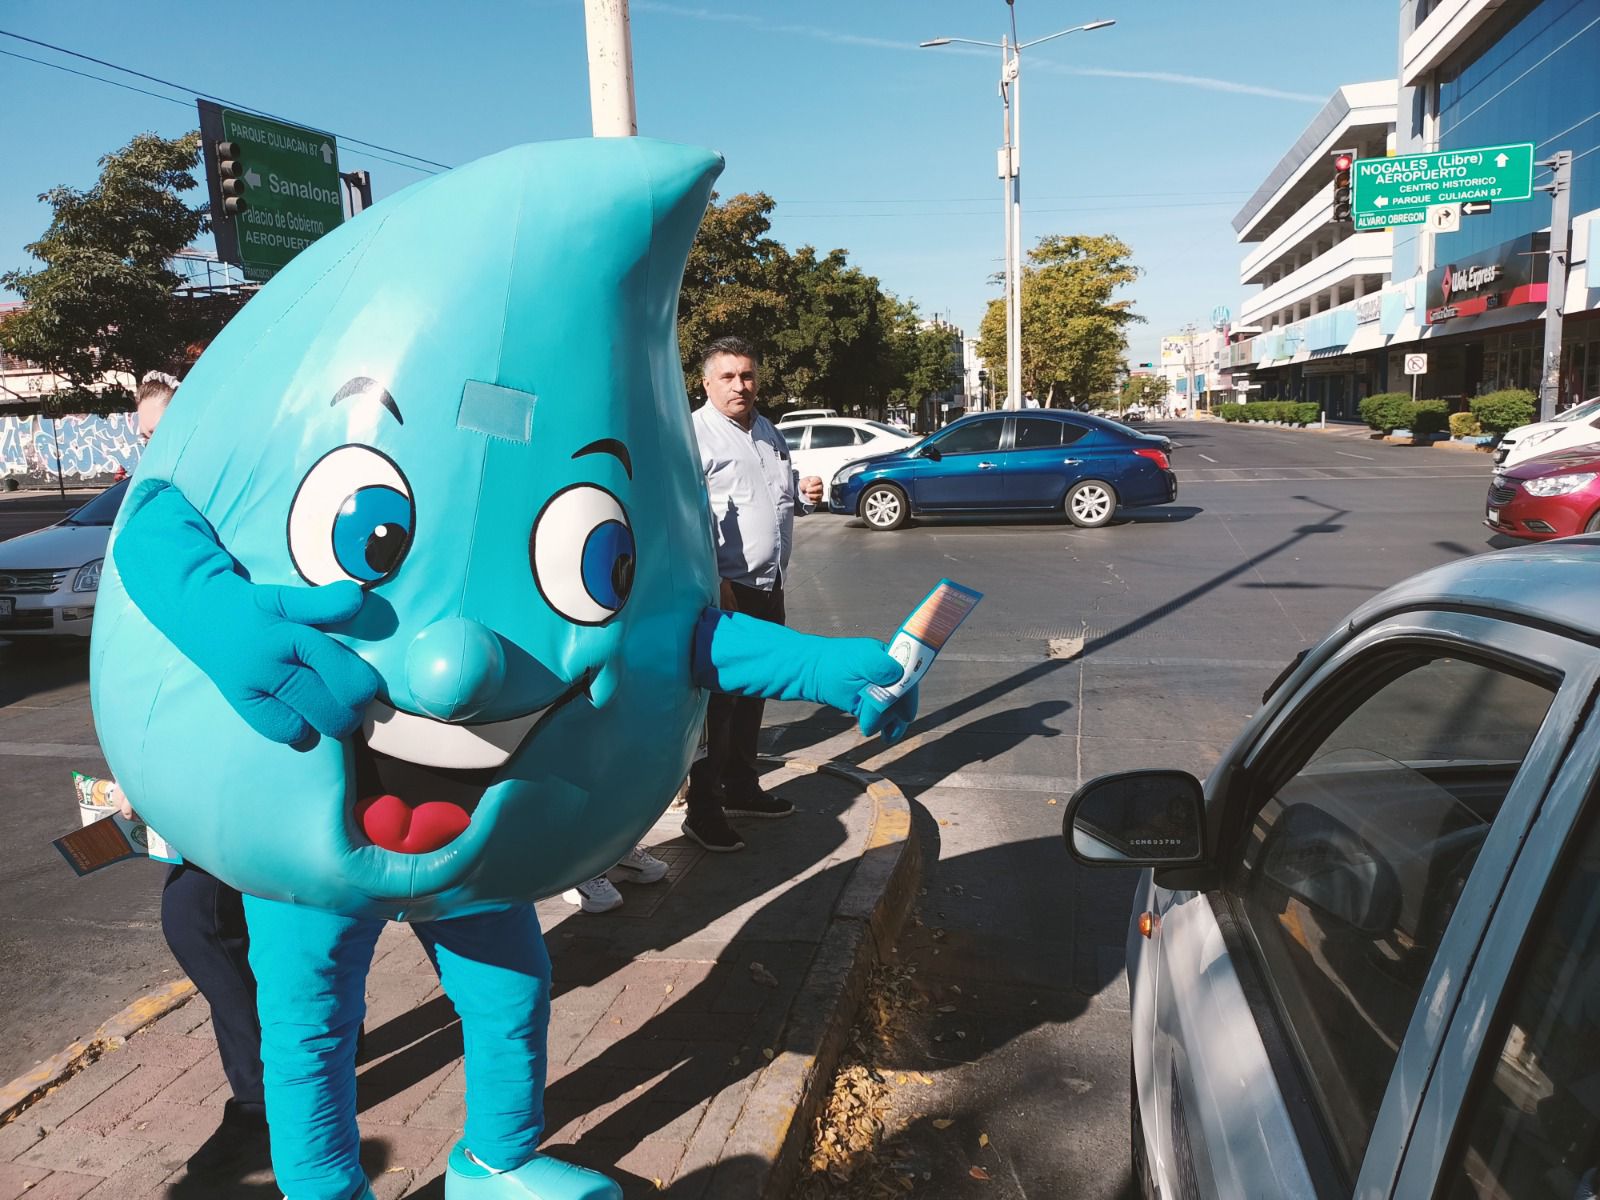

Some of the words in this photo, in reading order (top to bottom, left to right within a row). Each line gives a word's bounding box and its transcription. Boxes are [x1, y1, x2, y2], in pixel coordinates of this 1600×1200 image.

[231, 122, 267, 144] PARQUE
[309, 143, 318, 157] 87
[1360, 159, 1428, 176] NOGALES
[1438, 152, 1483, 169] (Libre)
[1375, 166, 1467, 184] AEROPUERTO
[268, 173, 340, 206] Sanalona
[1399, 182, 1439, 193] CENTRO
[1442, 176, 1497, 189] HISTORICO
[1392, 194, 1432, 205] PARQUE
[1489, 187, 1502, 196] 87
[242, 204, 273, 227] Palacio
[274, 209, 286, 229] de
[286, 211, 324, 235] Gobierno
[1358, 214, 1387, 227] ALVARO
[1387, 211, 1425, 225] OBREGON
[245, 230, 314, 250] AEROPUERT
[1468, 265, 1496, 291] Express
